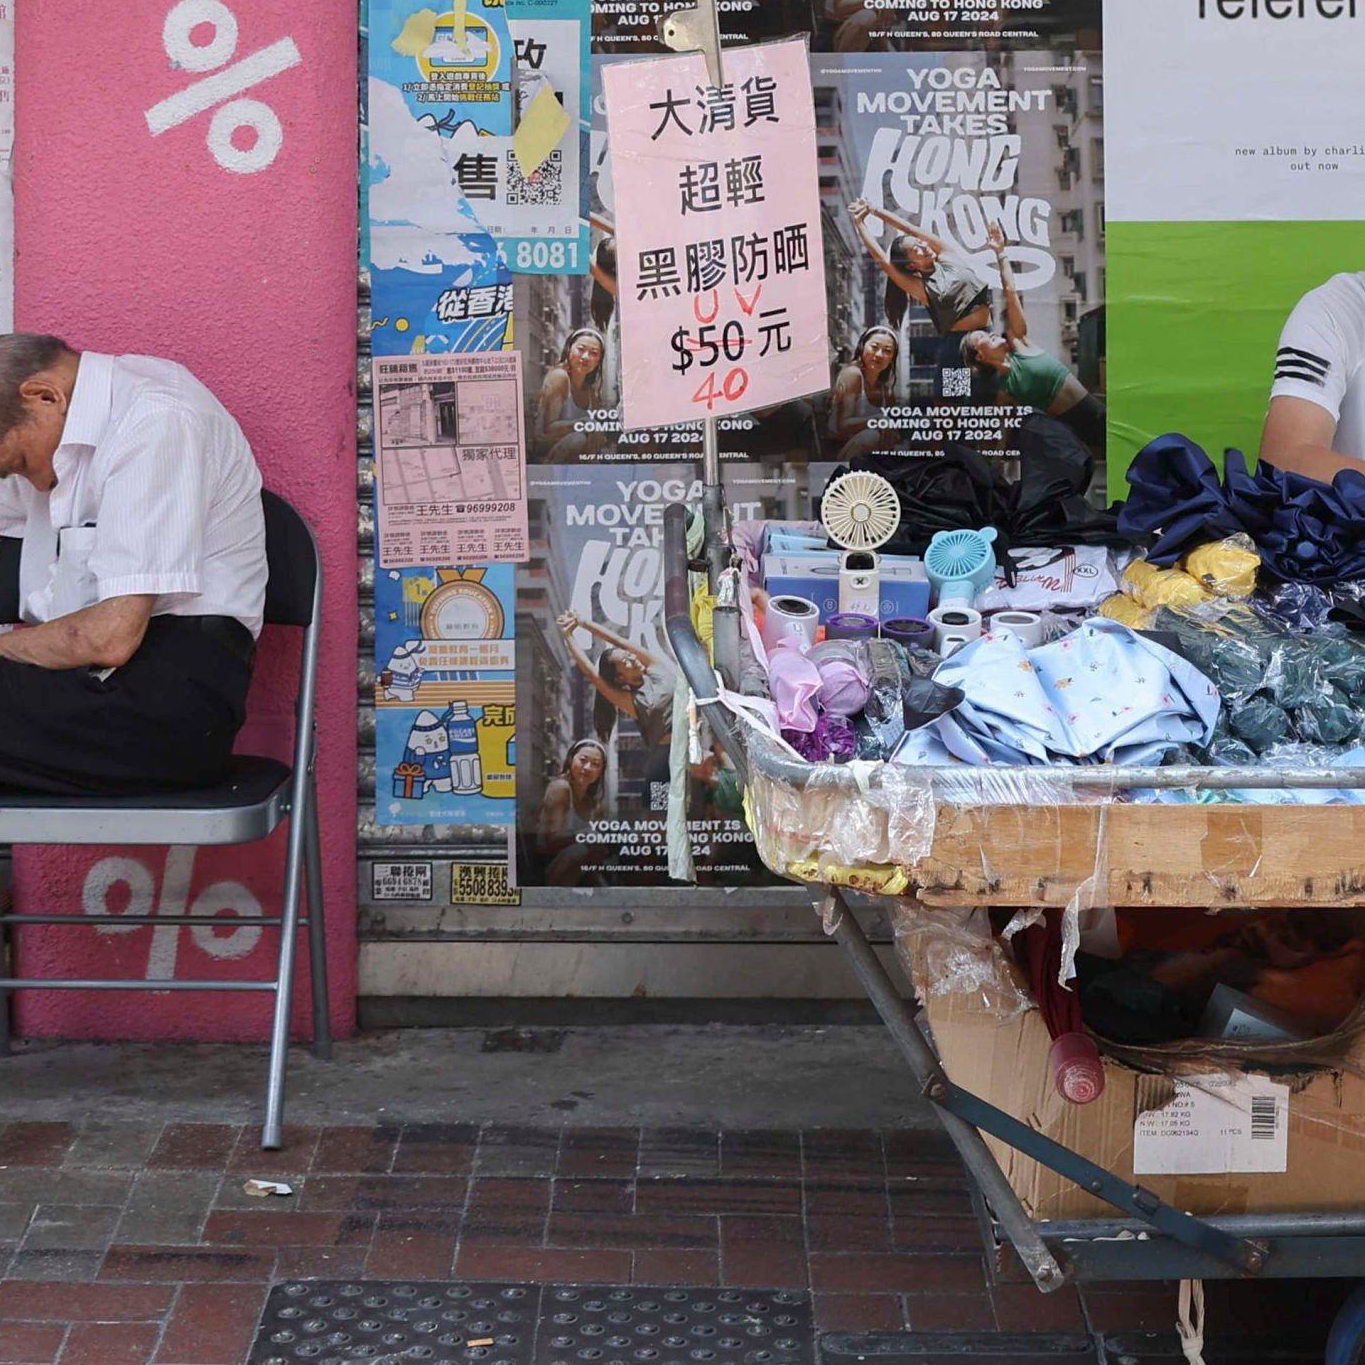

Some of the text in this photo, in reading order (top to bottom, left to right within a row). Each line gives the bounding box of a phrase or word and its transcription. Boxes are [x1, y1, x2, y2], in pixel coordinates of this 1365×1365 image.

[864, 0, 1043, 9] COMING TO HONG KONG
[908, 11, 1000, 22] AUG 17 2024
[1235, 147, 1255, 155] new
[1263, 146, 1297, 156] album
[1304, 146, 1317, 157] by
[1325, 145, 1365, 156] charli
[1290, 162, 1339, 171] out now
[678, 154, 765, 217] 超輕
[517, 242, 578, 268] 8081
[636, 222, 810, 300] 黑膠防晒
[757, 307, 792, 357] 元
[692, 368, 750, 411] 40
[462, 448, 517, 461] 獨家代理
[416, 503, 516, 517] 王先生 96999208
